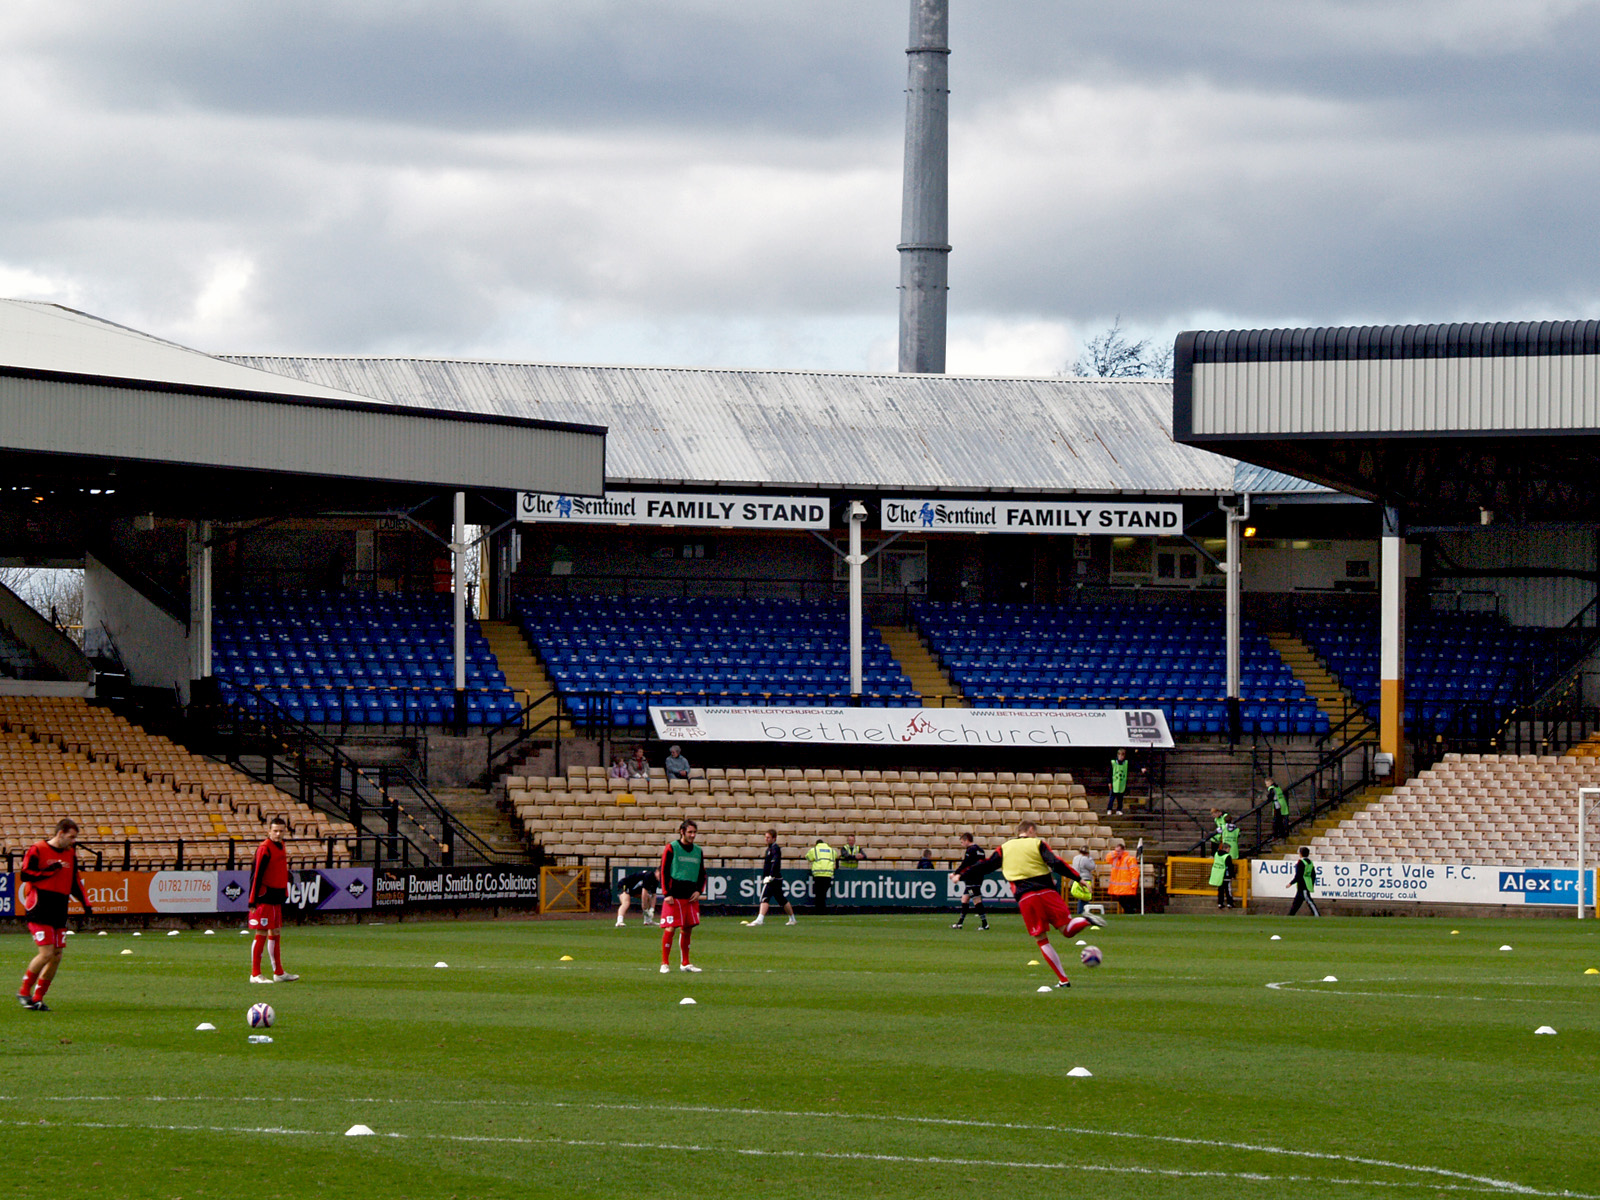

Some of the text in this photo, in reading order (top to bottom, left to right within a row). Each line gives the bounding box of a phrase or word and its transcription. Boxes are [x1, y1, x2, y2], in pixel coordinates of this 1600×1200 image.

[522, 492, 825, 522] The Sentinel FAMILY STAND
[886, 503, 1179, 528] The Sentinel FAMILY STAND
[1125, 711, 1157, 727] HD
[761, 721, 900, 743] bethel
[937, 723, 1072, 744] church
[1334, 865, 1350, 876] to
[1359, 864, 1393, 877] Port
[1402, 865, 1435, 878] Vale
[158, 879, 212, 892] 01782 717766
[285, 875, 321, 909] eyd
[376, 877, 405, 891] Browell
[408, 873, 537, 893] Browell Smith & Co Solicitors
[739, 875, 816, 898] steet
[1336, 878, 1373, 888] 01270
[1378, 879, 1428, 889] 250800
